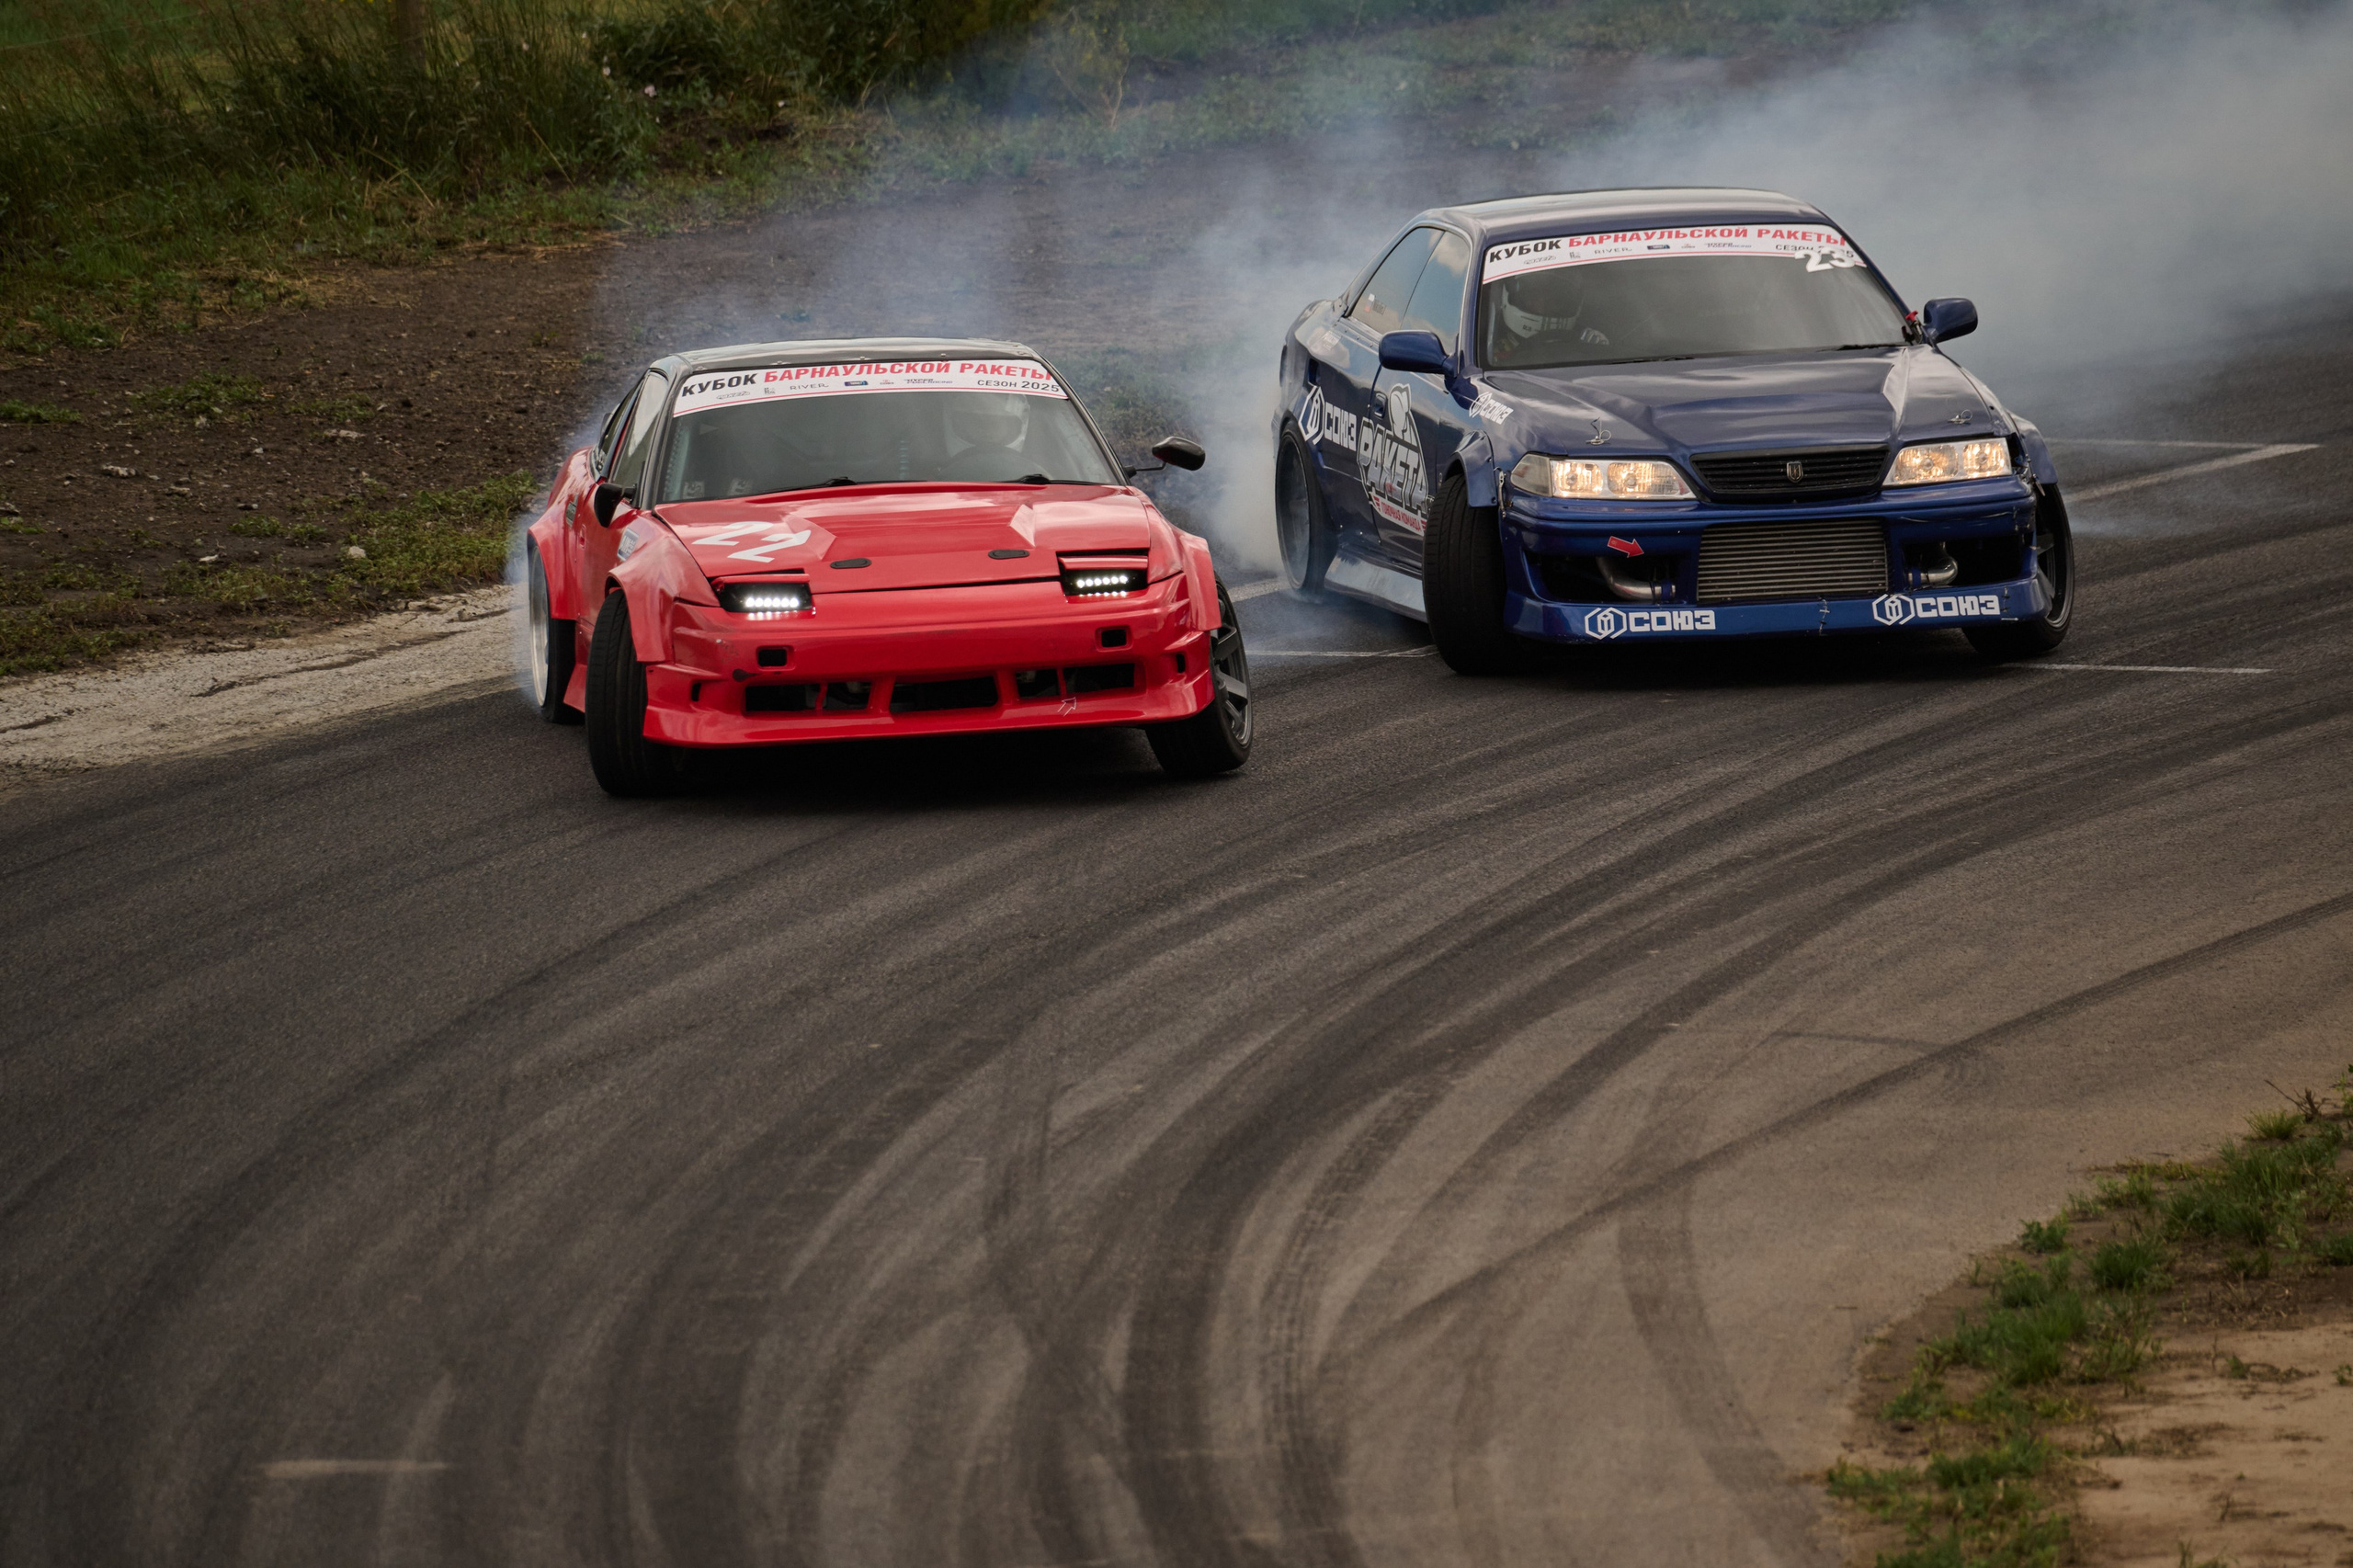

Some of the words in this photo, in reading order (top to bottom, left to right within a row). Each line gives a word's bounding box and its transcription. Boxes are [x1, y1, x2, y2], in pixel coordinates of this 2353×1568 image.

[1489, 239, 1562, 264] КУБОК
[1568, 227, 1748, 248] БАРНАУЛЬСКОЙ
[1756, 228, 1846, 246] РАКЕТЫ
[1794, 246, 1856, 273] 23
[681, 372, 758, 397] КУБОК
[763, 360, 950, 383] БАРНАУЛЬСКОЙ
[959, 362, 1053, 381] РАКЕТЫ
[977, 380, 1017, 389] СЕЗОН
[1021, 381, 1061, 392] 2025
[1324, 402, 1358, 452] СОЮЗ
[1479, 398, 1515, 426] СОЮЗ
[1358, 418, 1428, 516] РАКЕТА
[691, 520, 812, 563] 22
[1628, 609, 1716, 632] СОЮЗ
[1915, 595, 2001, 619] СОЮЗ
